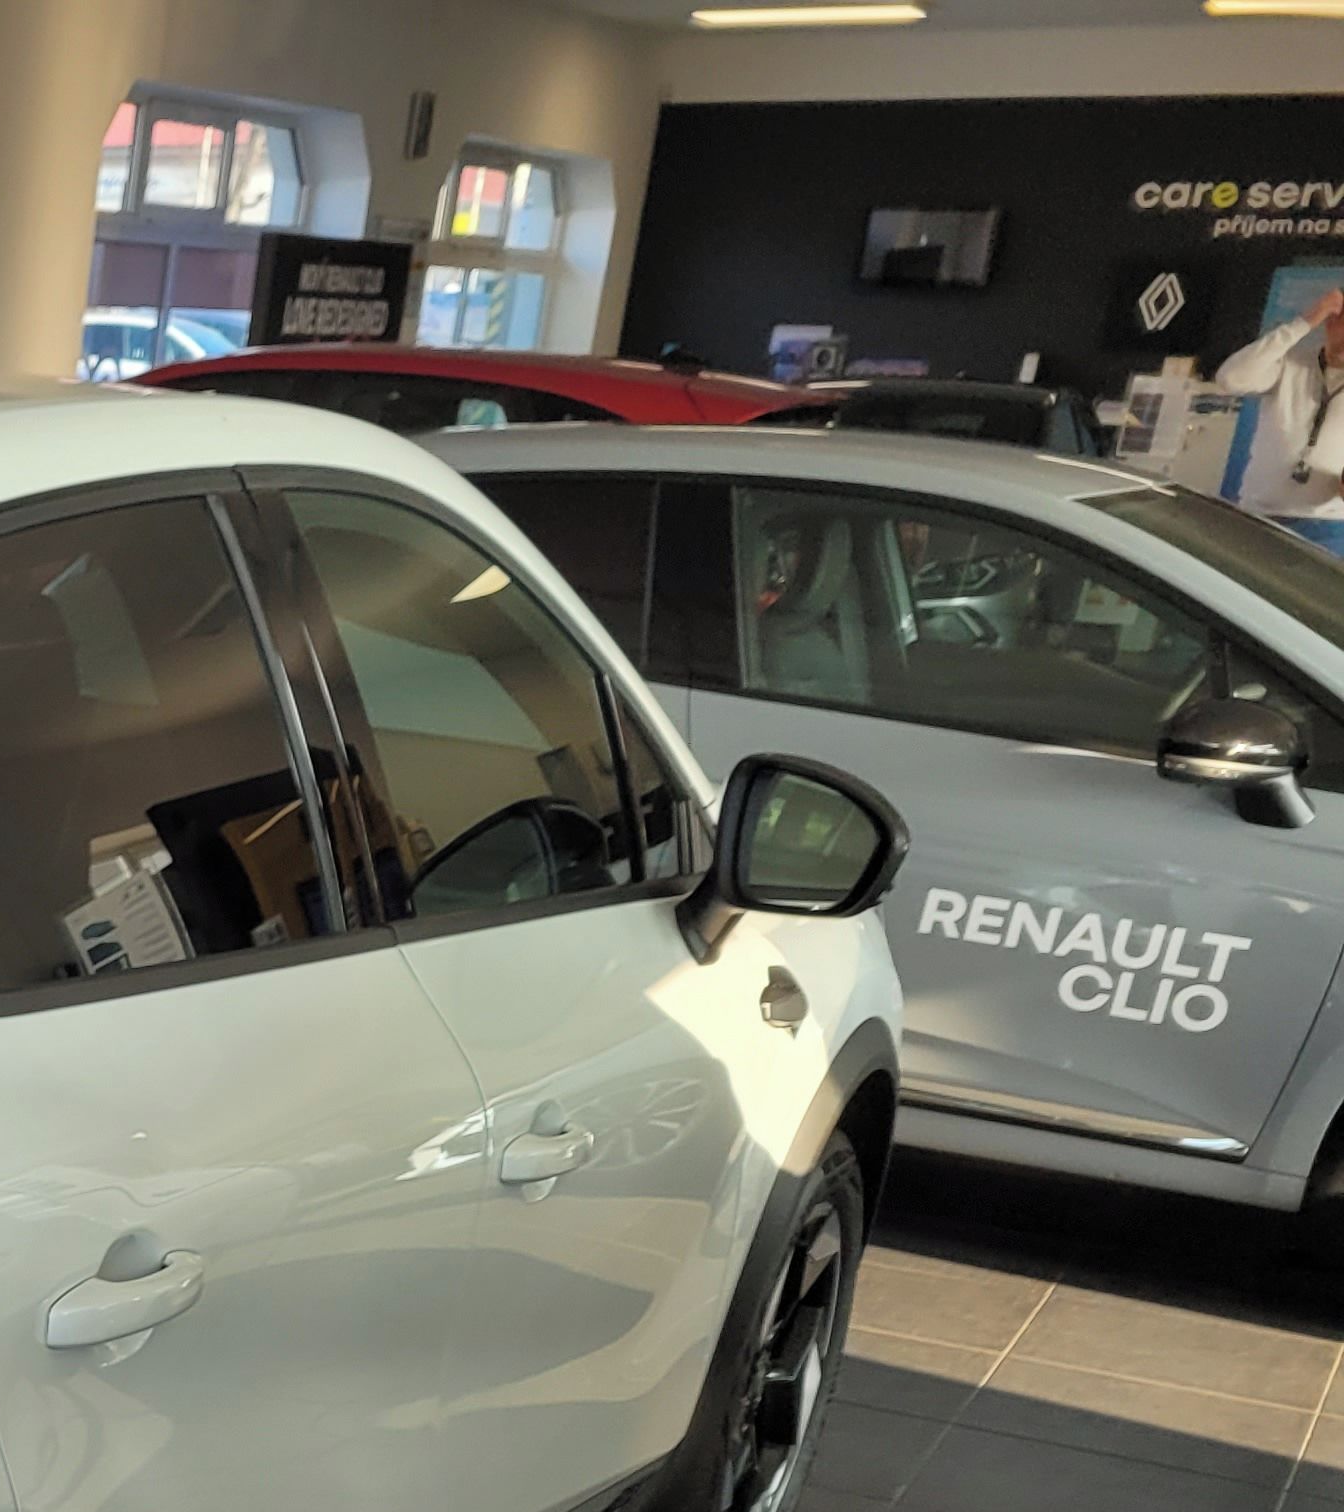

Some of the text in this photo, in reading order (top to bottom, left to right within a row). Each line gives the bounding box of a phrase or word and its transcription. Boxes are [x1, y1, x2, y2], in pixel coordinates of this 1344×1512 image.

[1134, 181, 1240, 209] care
[1297, 218, 1331, 235] na
[916, 886, 1253, 983] RENAULT
[1057, 963, 1230, 1033] CLIO
